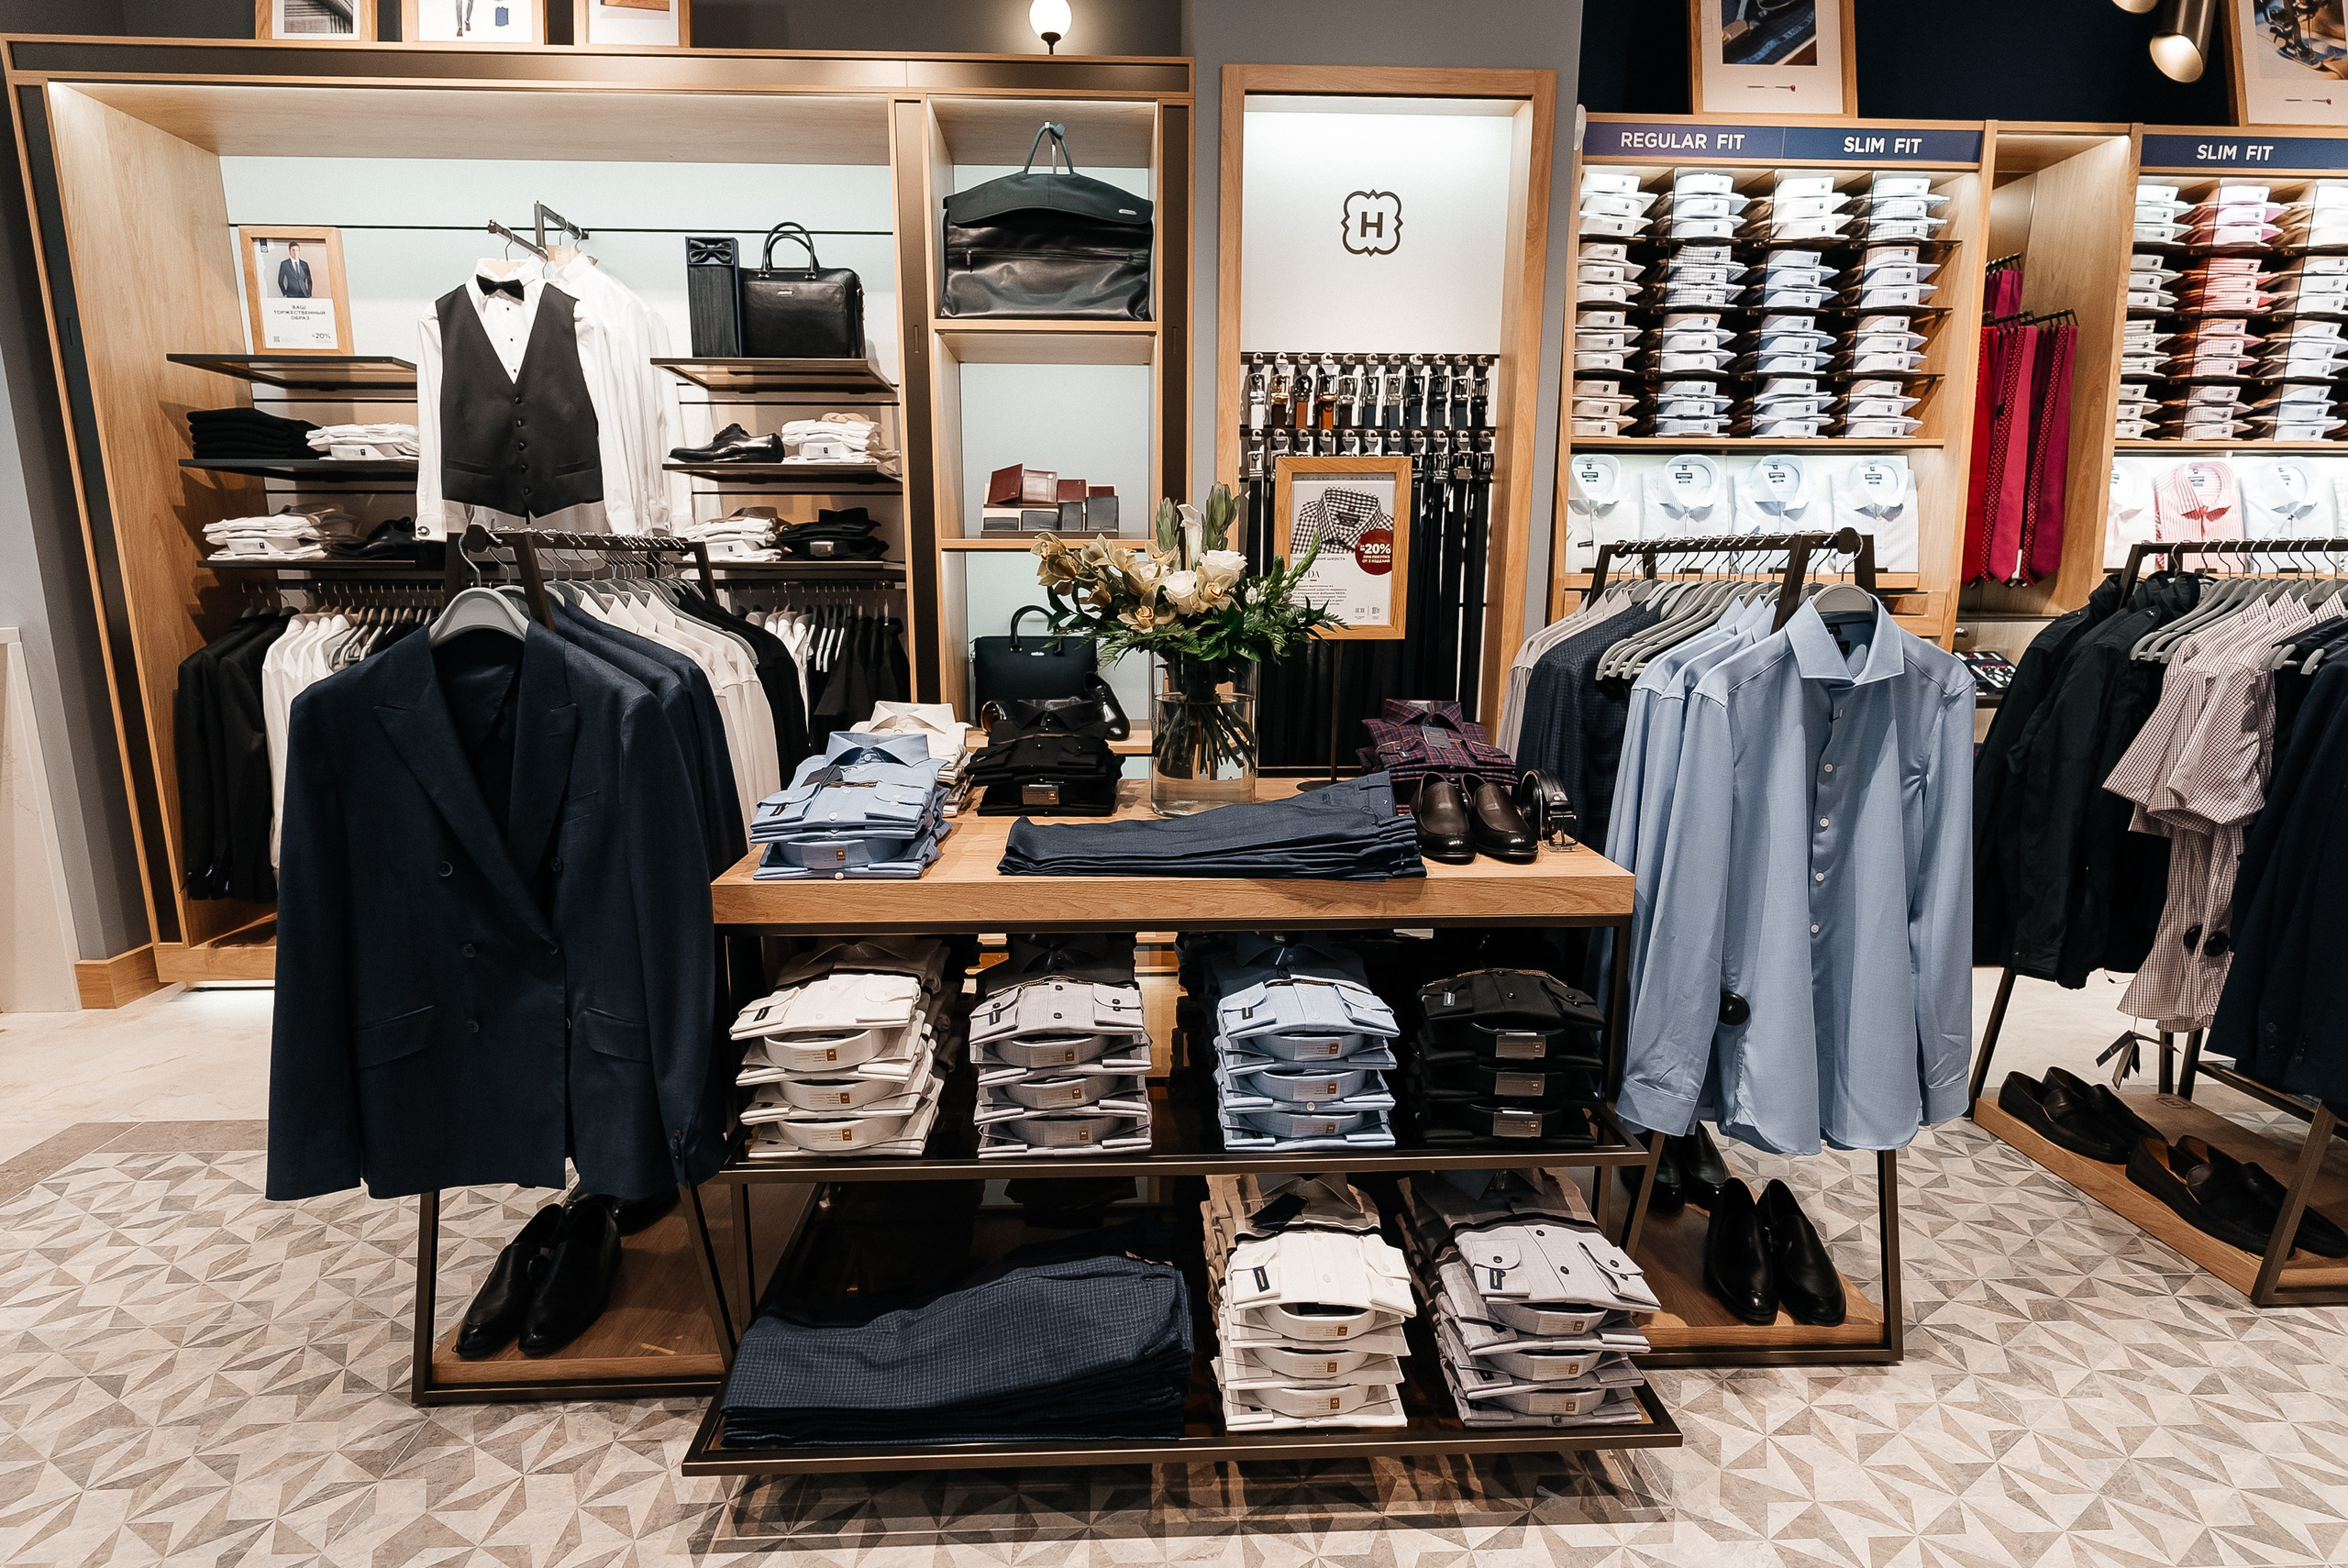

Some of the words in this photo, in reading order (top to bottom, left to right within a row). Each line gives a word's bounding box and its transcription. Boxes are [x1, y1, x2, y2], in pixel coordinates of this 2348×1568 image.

[1620, 132, 1708, 150] REGULAR
[1716, 134, 1745, 151] FIT
[1843, 136, 1886, 154] SLIM
[1893, 138, 1922, 155] FIT
[2196, 144, 2238, 160] SLIM
[2245, 145, 2275, 161] FIT
[1360, 211, 1384, 238] H
[1359, 543, 1391, 555] -20%
